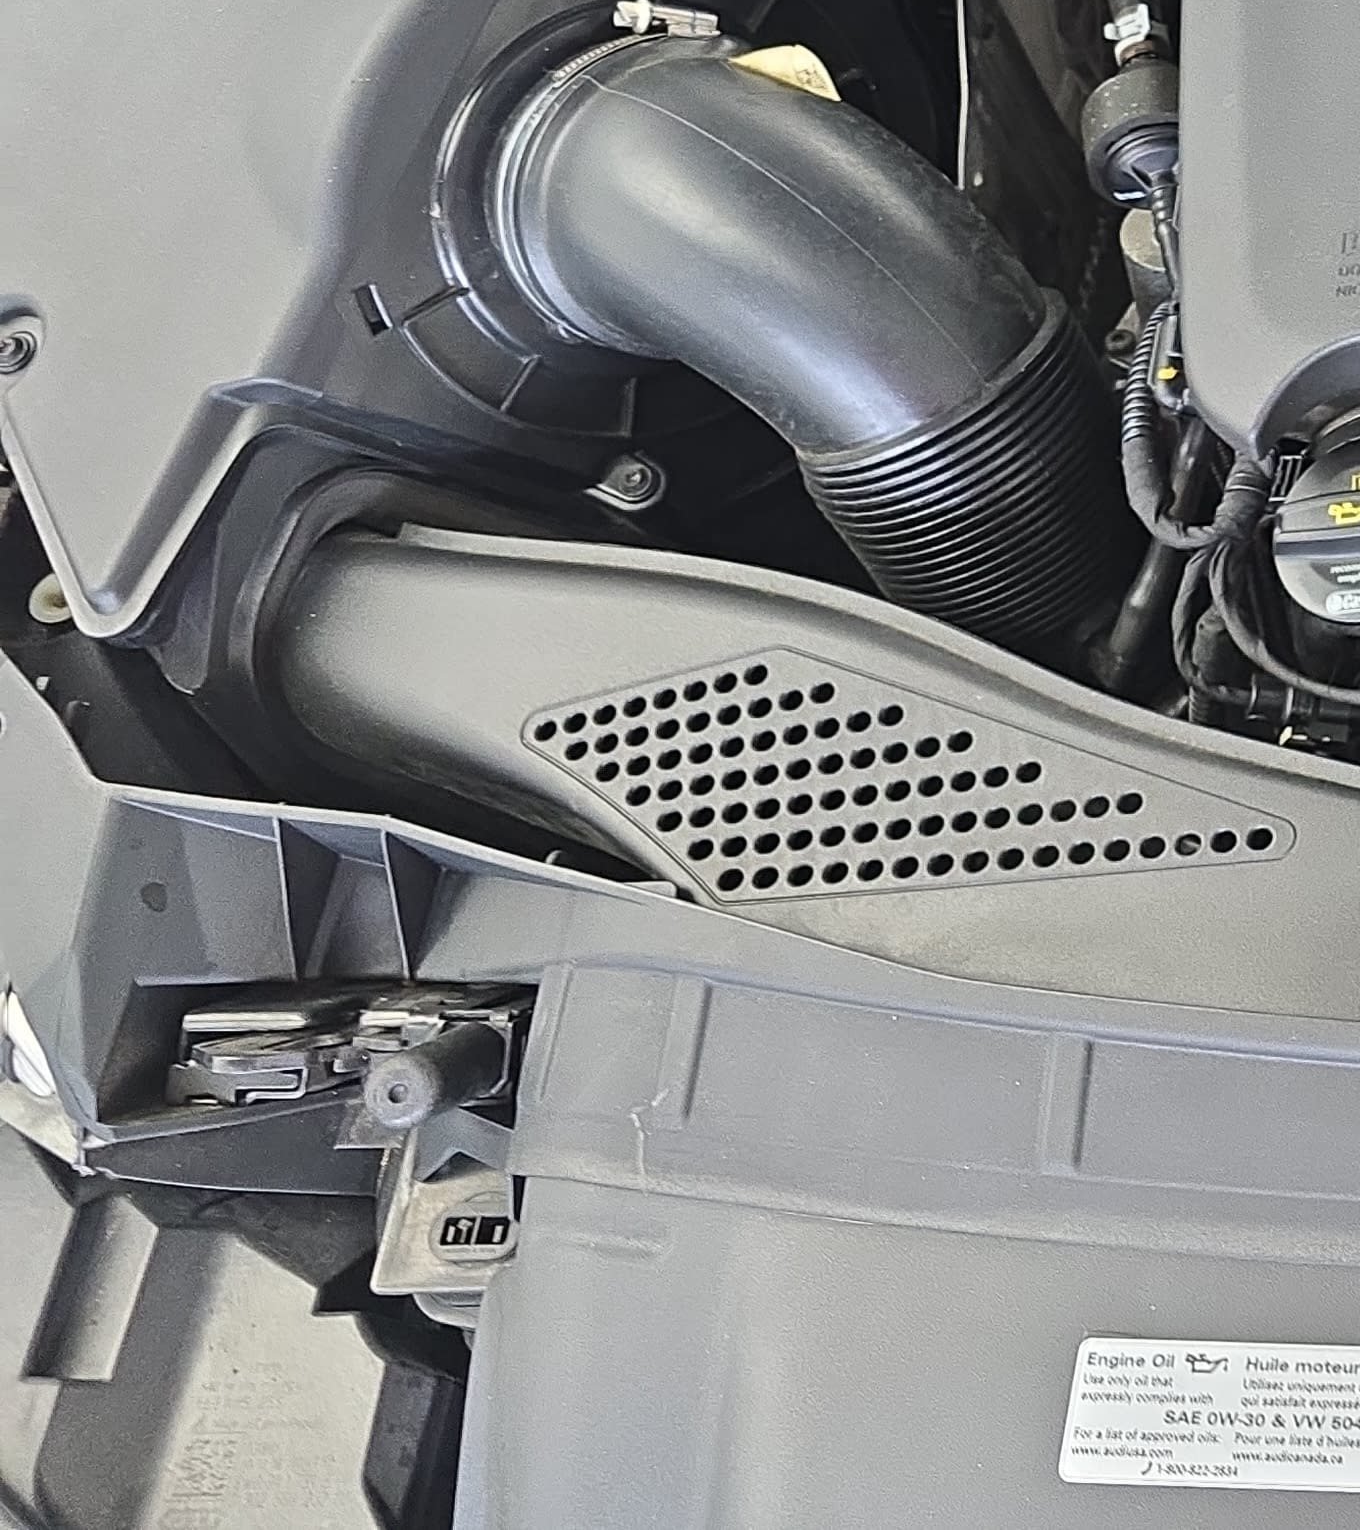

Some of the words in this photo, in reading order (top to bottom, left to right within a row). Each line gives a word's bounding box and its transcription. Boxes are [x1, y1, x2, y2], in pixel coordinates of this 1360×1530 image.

[1086, 1351, 1146, 1370] Engine
[1151, 1353, 1176, 1368] Oil
[1244, 1356, 1290, 1372] Huile
[1082, 1373, 1105, 1385] Use
[1105, 1374, 1131, 1386] only
[1133, 1375, 1150, 1386] oil
[1150, 1375, 1174, 1387] that
[1162, 1409, 1202, 1425] SAE
[1205, 1411, 1266, 1427] 0W-30
[1270, 1413, 1287, 1427] &
[1290, 1413, 1326, 1429] VW
[1070, 1444, 1174, 1458] www.audiusa.com
[1230, 1450, 1344, 1464] www.audicanada.ca
